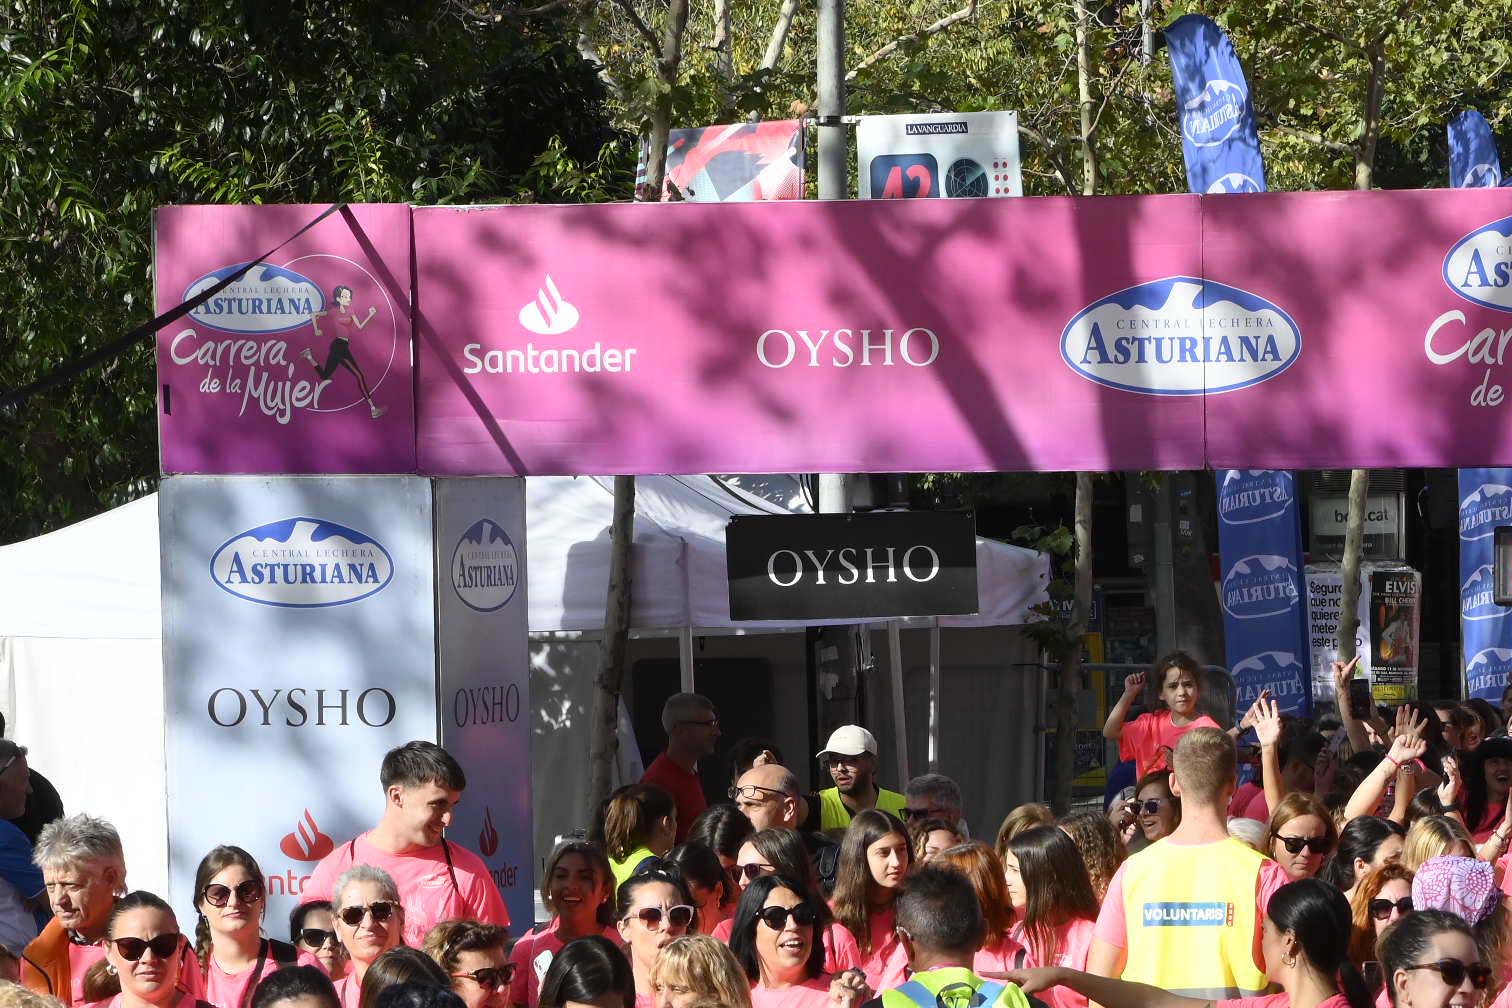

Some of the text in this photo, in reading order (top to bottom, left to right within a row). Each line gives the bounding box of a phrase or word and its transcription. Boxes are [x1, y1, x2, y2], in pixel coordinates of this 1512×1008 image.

[193, 288, 314, 316] ASTURIANA
[223, 286, 310, 295] ENTRAL LECHERA
[1116, 317, 1274, 330] CENTRAL LECHERA
[170, 328, 288, 366] Carrera
[463, 342, 637, 376] Santander
[756, 328, 940, 368] OYSHO
[1080, 321, 1282, 365] ASTURIANA
[199, 359, 333, 425] de la Mujer
[1470, 368, 1505, 407] de
[225, 552, 380, 584] ASTURIANA
[252, 549, 375, 558] CENTRAL LECHERA
[767, 545, 941, 587] OYSHO
[457, 553, 515, 589] ASTURIANA
[1385, 580, 1416, 593] ELVIS
[1310, 599, 1327, 609] que
[1311, 610, 1342, 623] quiere
[1312, 637, 1331, 648] este
[207, 687, 396, 727] OYSHO
[455, 683, 521, 728] OYSHO
[1144, 908, 1224, 921] VOLUNTARIS
